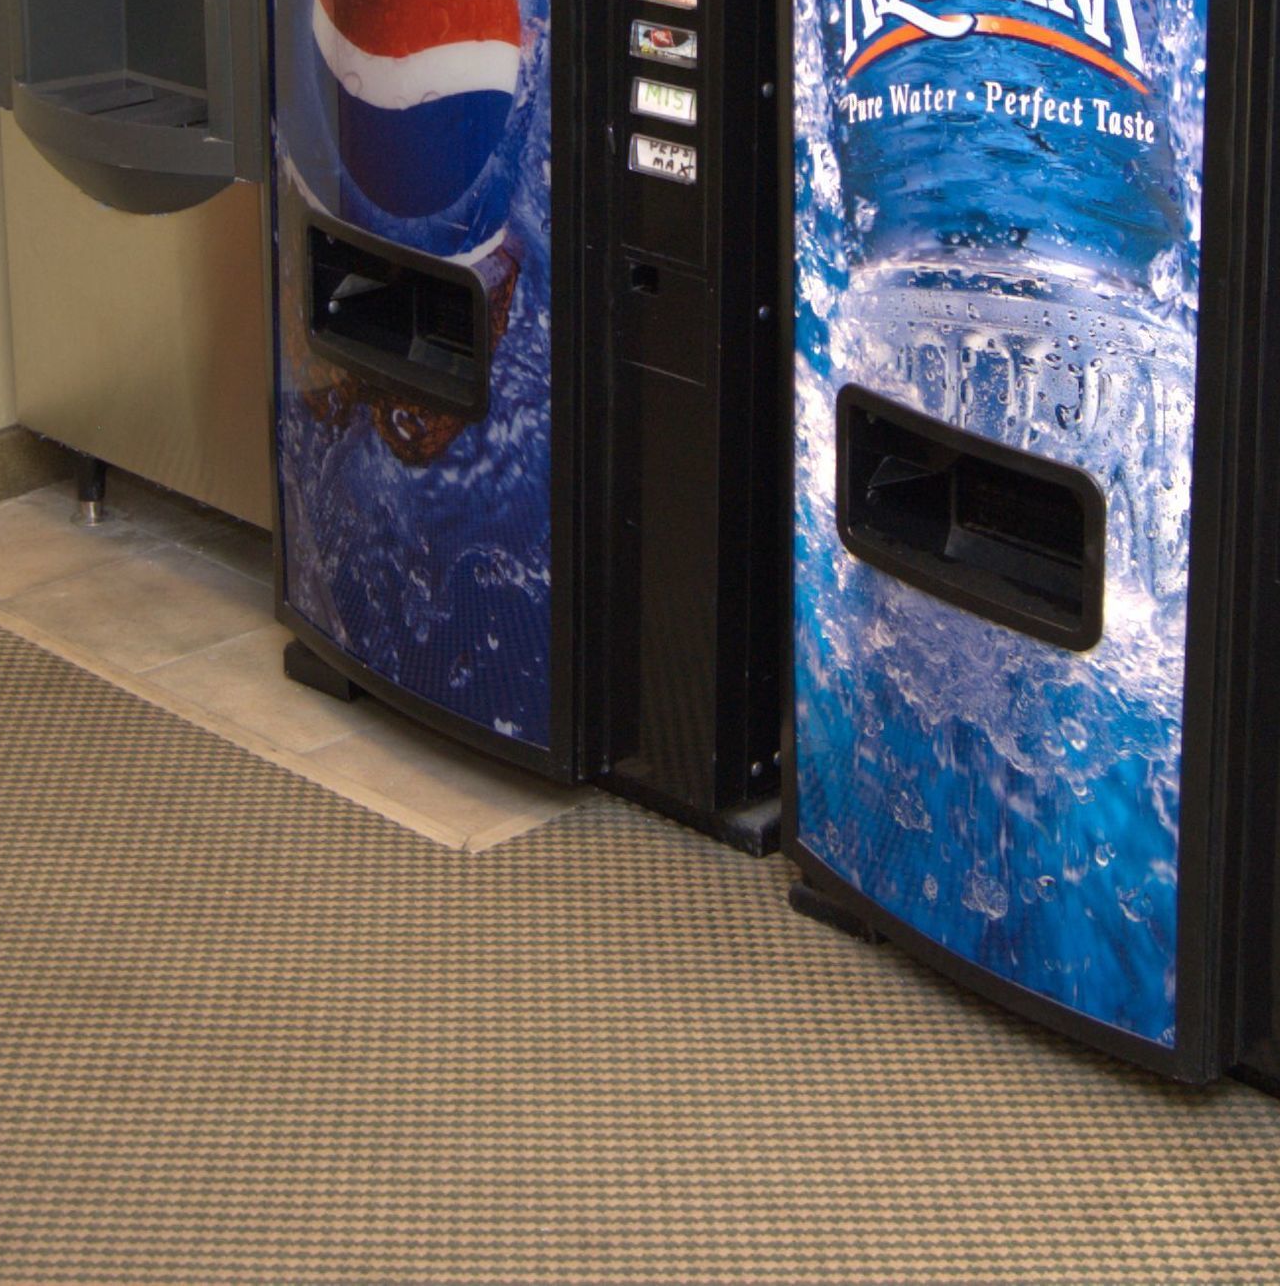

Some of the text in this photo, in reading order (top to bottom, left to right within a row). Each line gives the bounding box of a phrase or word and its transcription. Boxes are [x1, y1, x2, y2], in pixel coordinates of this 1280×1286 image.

[847, 80, 1155, 144] Pure Water Perfect Taste
